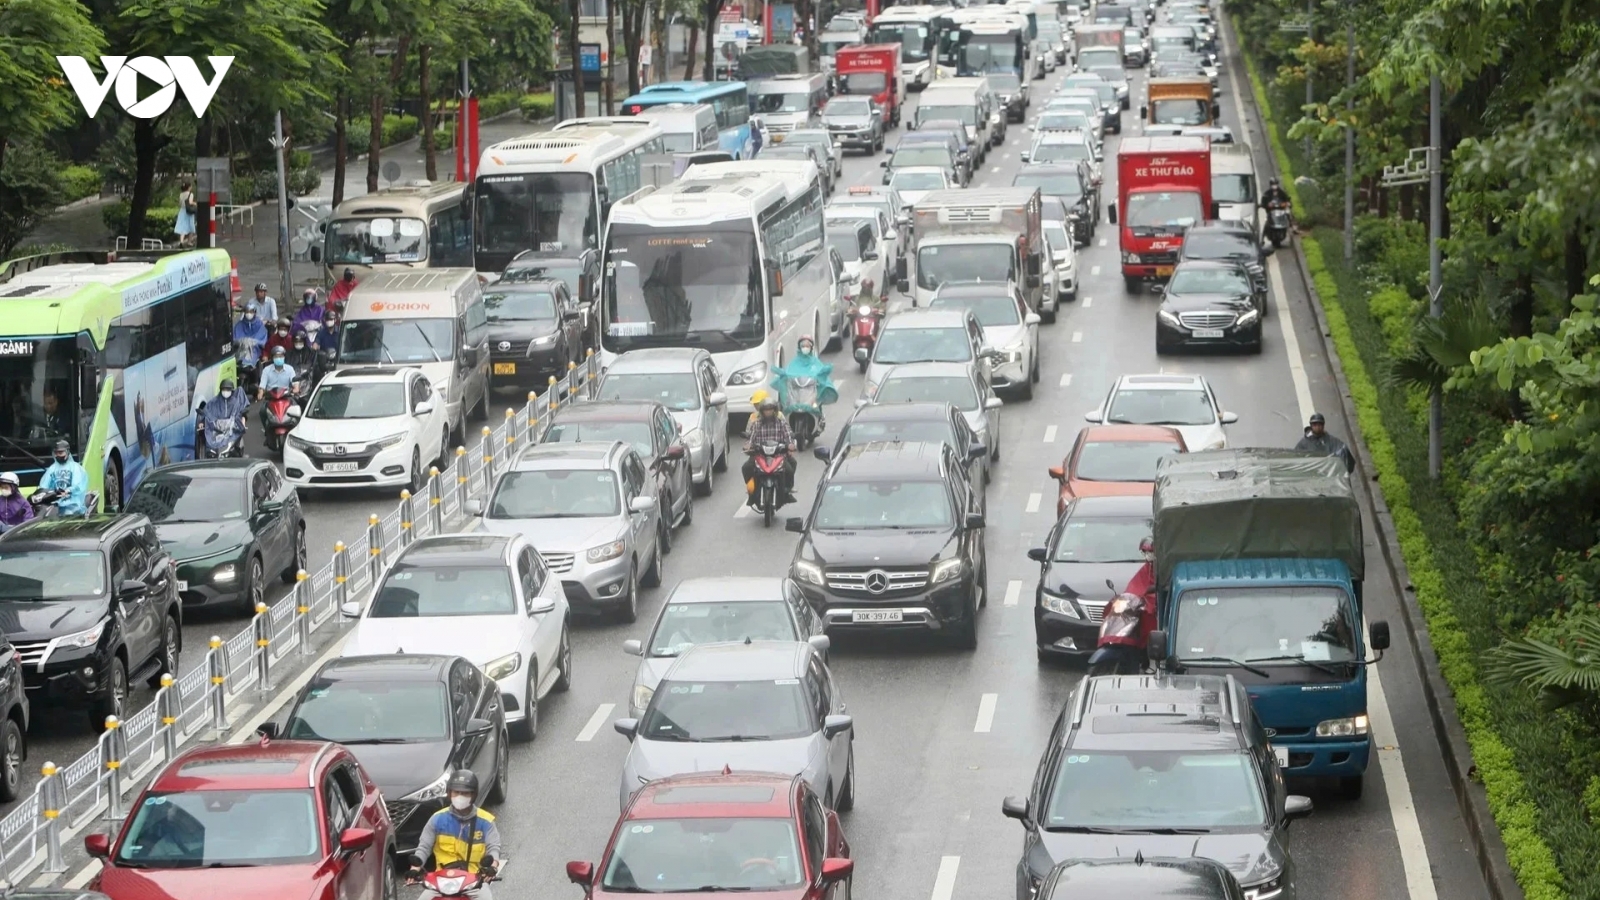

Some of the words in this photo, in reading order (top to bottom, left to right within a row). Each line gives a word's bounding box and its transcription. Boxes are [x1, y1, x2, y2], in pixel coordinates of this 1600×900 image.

[1135, 168, 1148, 176] XE
[1151, 166, 1172, 176] THƯ
[1173, 164, 1194, 176] BÁO
[1149, 241, 1169, 249] J&T
[386, 302, 431, 311] ORION
[856, 612, 900, 621] 30K-397.46
